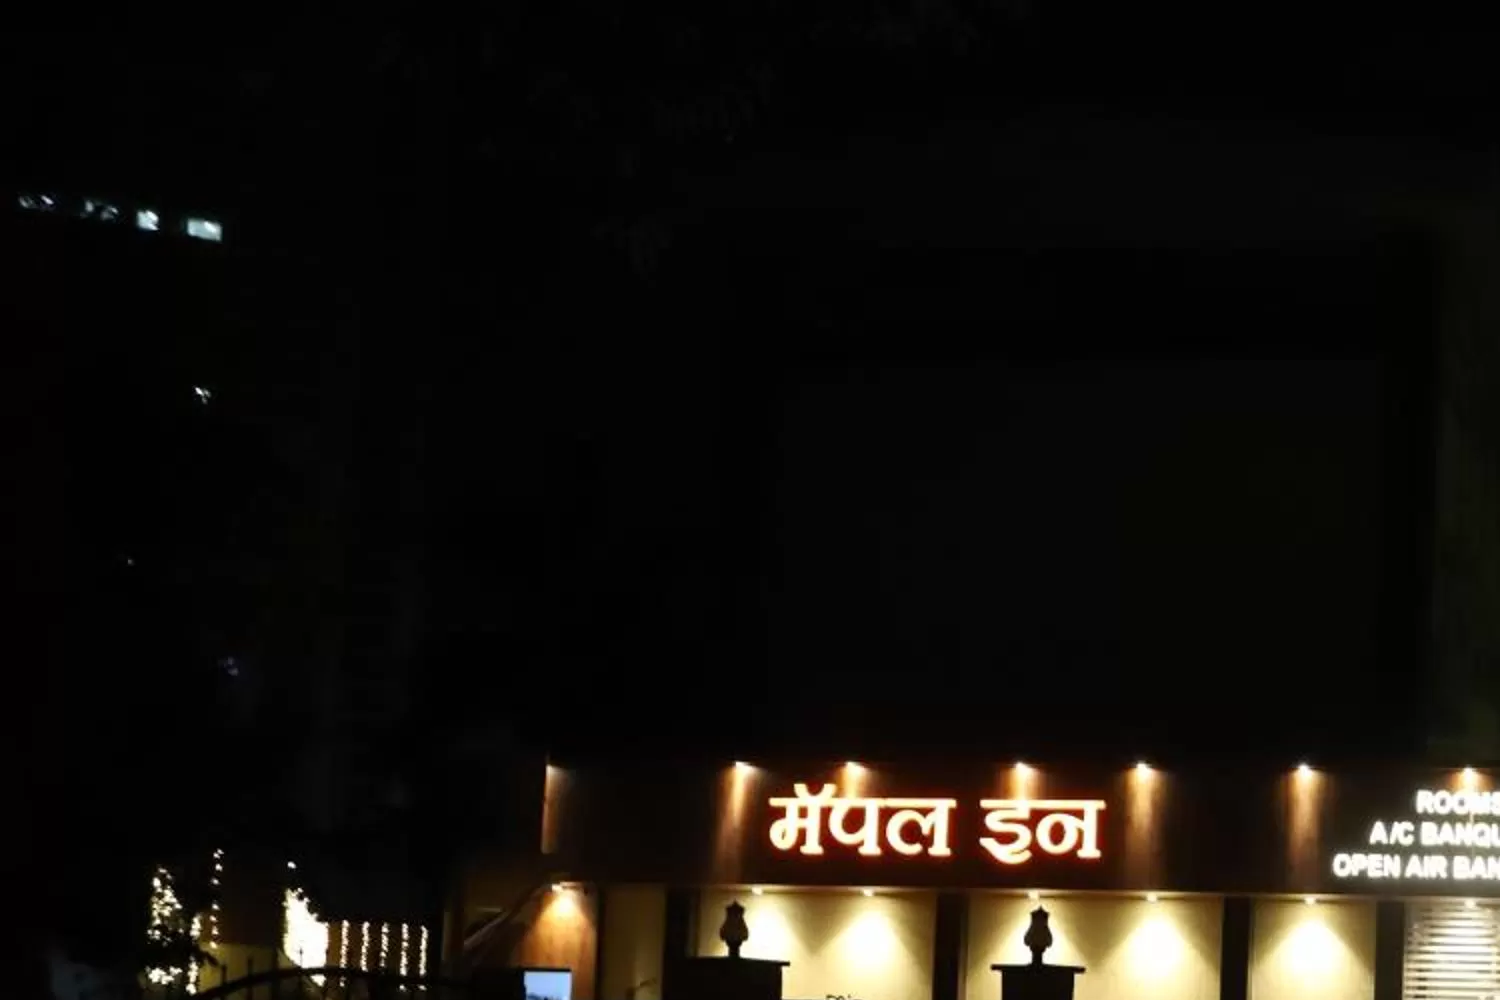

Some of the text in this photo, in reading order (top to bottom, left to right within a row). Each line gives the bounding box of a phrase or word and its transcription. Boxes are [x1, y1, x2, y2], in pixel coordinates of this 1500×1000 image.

[979, 799, 1106, 865] इन
[1369, 821, 1415, 846] A/C
[1332, 853, 1401, 879] OPEN
[1404, 855, 1448, 879] AIR
